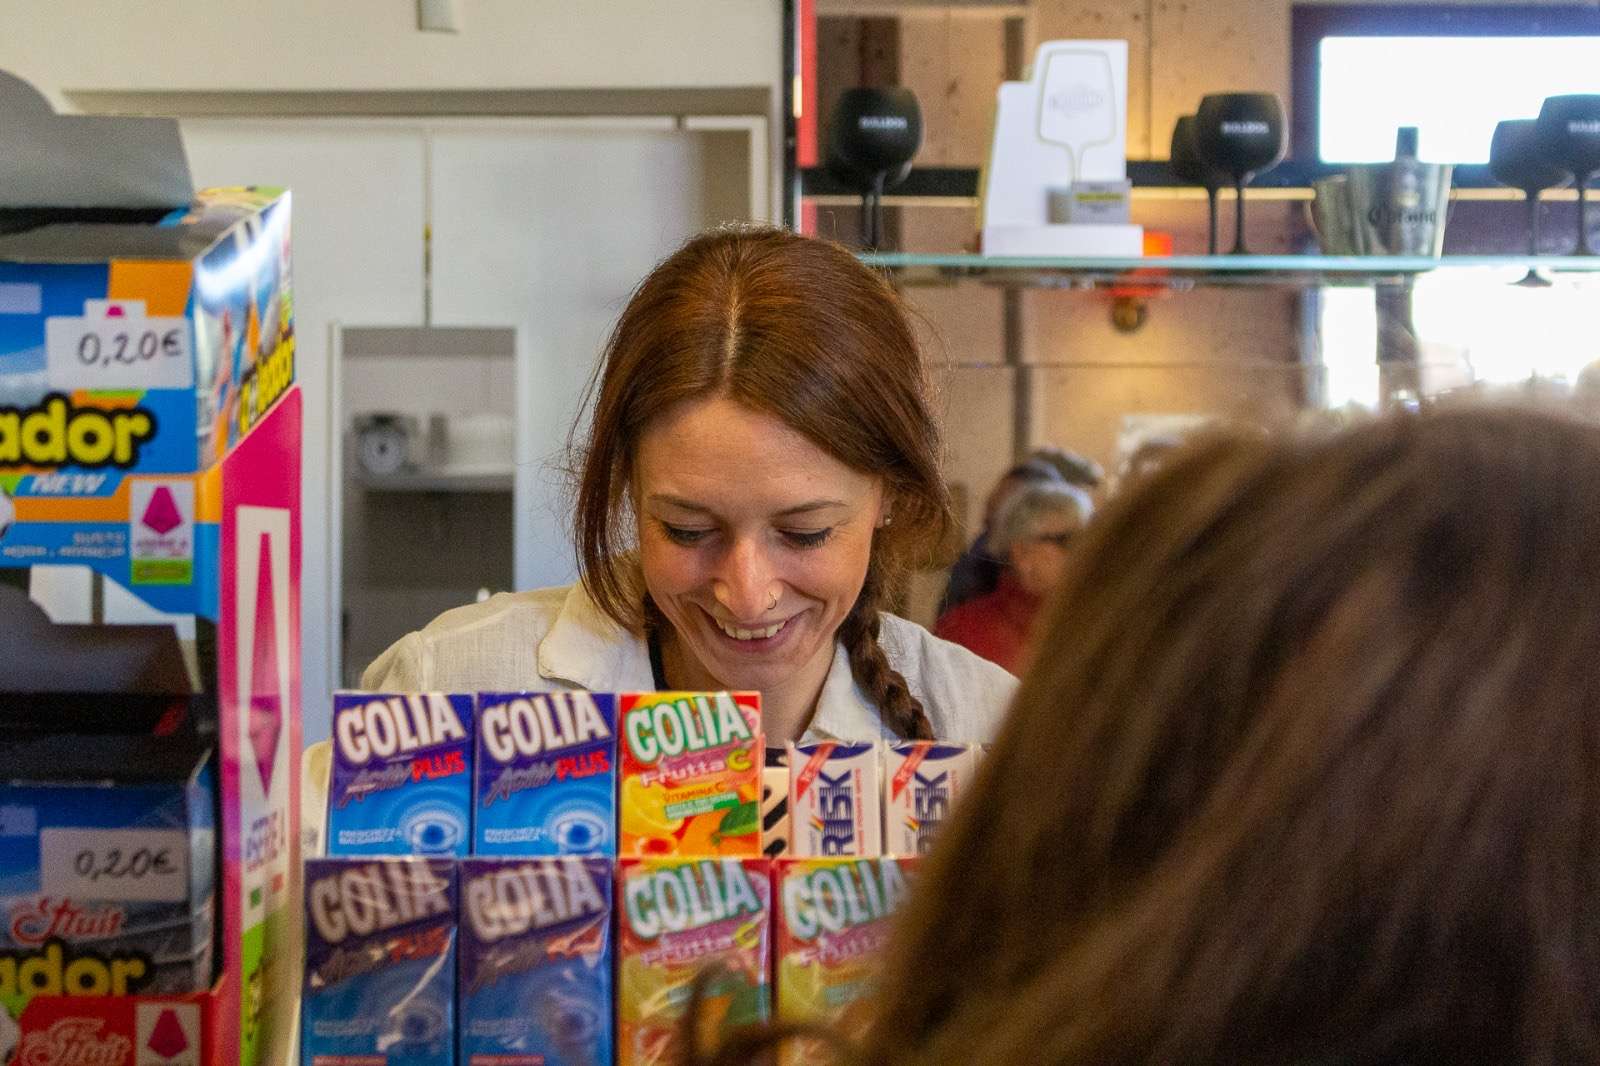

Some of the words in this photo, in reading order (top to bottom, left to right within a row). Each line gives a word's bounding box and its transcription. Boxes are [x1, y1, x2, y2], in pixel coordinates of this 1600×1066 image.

[78, 328, 184, 368] 0,20€
[30, 472, 107, 494] NEW
[411, 751, 466, 783] PLUS
[555, 750, 610, 782] PLUS
[639, 757, 726, 788] Frutta
[74, 849, 178, 883] 0,20€
